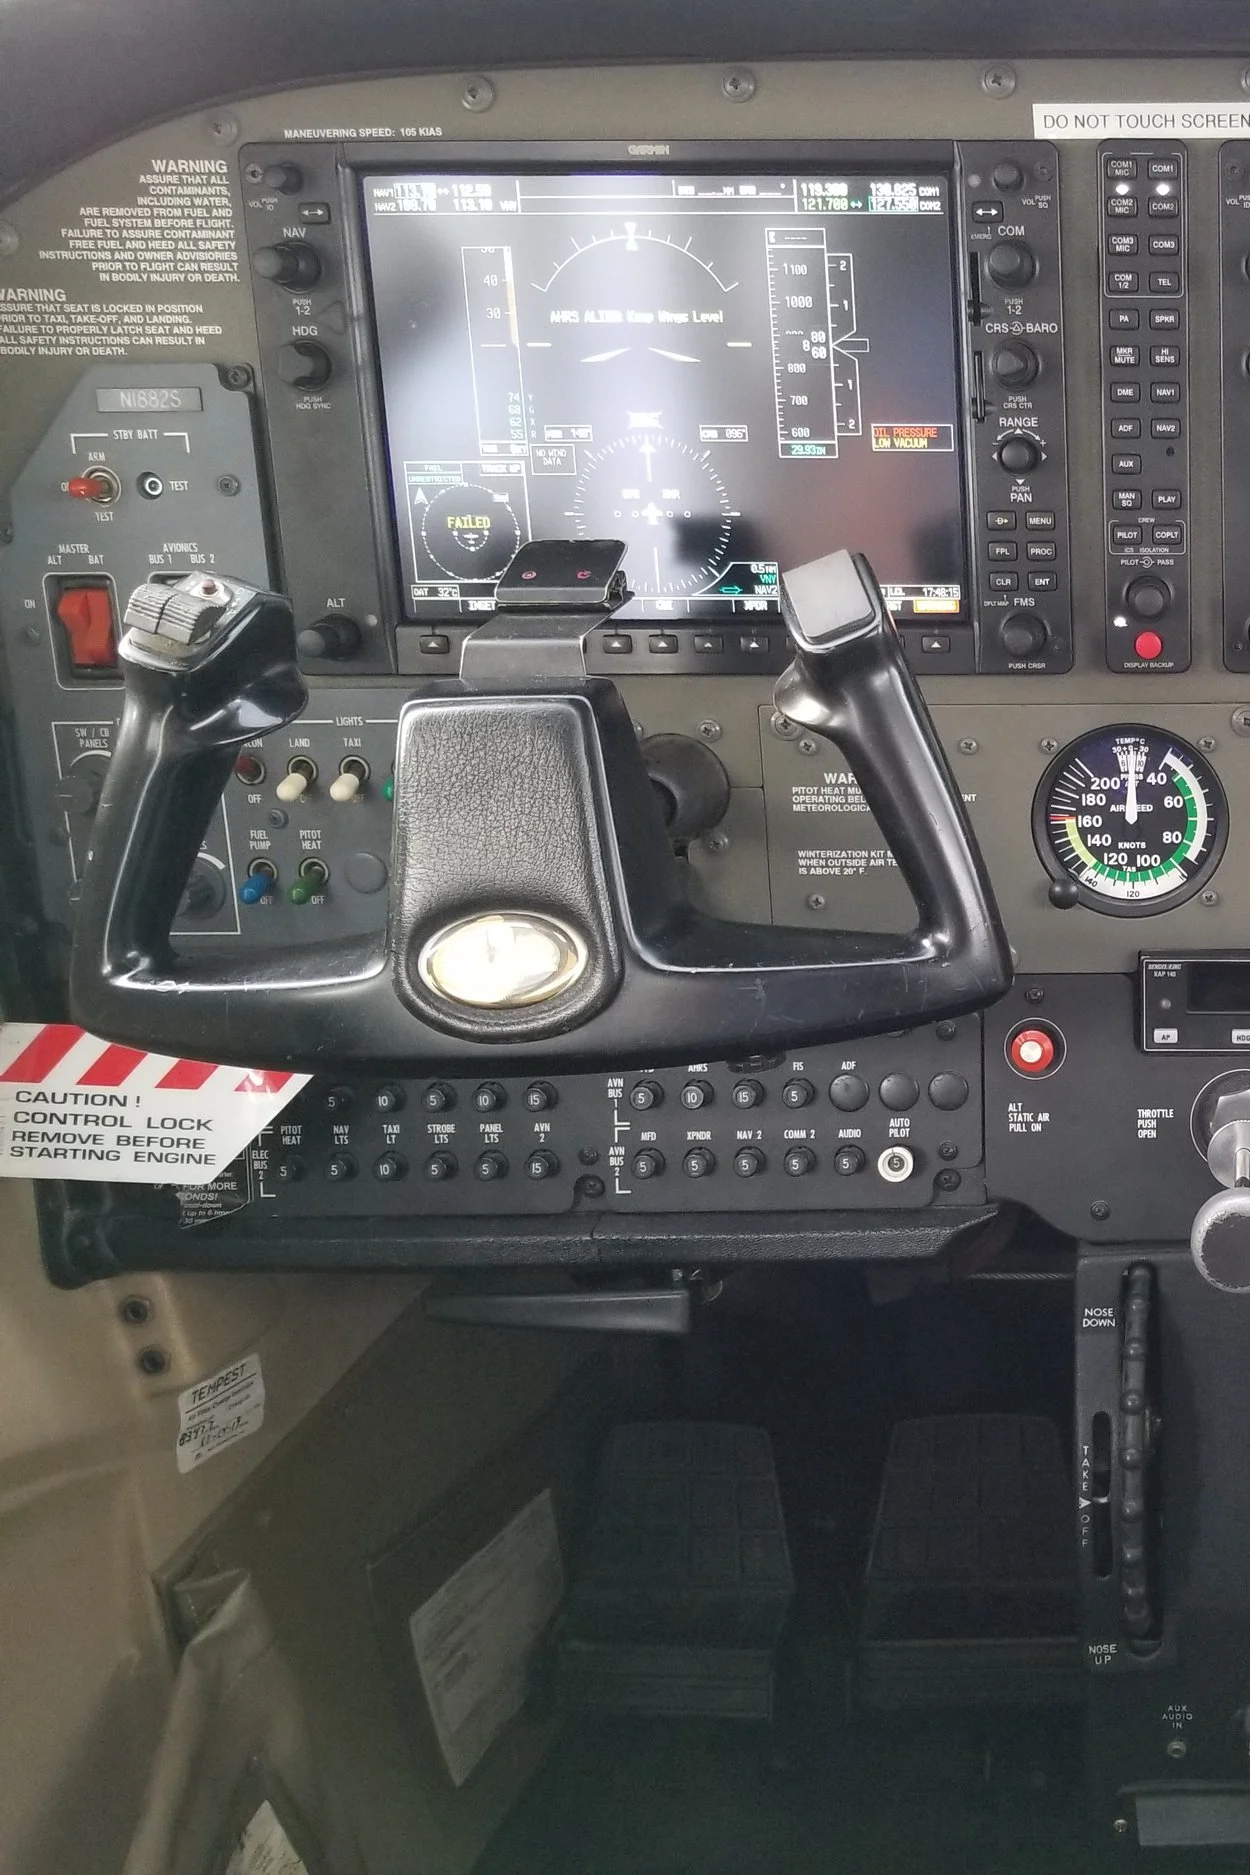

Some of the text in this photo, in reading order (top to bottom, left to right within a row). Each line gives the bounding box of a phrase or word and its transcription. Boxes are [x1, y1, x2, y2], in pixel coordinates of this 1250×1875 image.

[1044, 115, 1068, 128] DO
[1075, 115, 1109, 128] NOT
[1116, 114, 1174, 128] TOUCH
[284, 127, 442, 138] MANEUVERING SPEED: 105 KIAS
[152, 160, 227, 172] WARNING
[140, 175, 229, 184] ASSURE THAT ALL
[150, 186, 230, 196] CONTAMINANTS,
[138, 197, 231, 206] INCLUDING WATER,
[85, 218, 233, 227] FUEL SYSTEM BEFORE FLIGHT.
[283, 228, 305, 237] NAV
[998, 226, 1024, 236] COM
[783, 263, 807, 274] 1100
[100, 273, 109, 281] IN
[112, 273, 147, 281] BODILY
[188, 274, 202, 282] OR
[204, 274, 240, 282] DEATH.
[785, 296, 812, 307] 1000
[76, 347, 90, 355] OR
[92, 347, 127, 355] DEATH.
[1115, 355, 1134, 363] MUTE
[790, 396, 808, 405] 700
[1000, 417, 1038, 428] RANGE
[114, 430, 158, 439] STBY BATT
[790, 428, 809, 437] 600
[873, 426, 936, 439] OIL PRESSURE
[874, 438, 927, 448] LOW VACUUM
[170, 481, 188, 490] TEST
[1011, 492, 1032, 502] PAN
[448, 516, 490, 530] FAILED
[59, 544, 90, 553] MASTER
[164, 543, 197, 552] AVIONICS
[48, 556, 61, 564] ALT
[88, 555, 103, 564] BAT
[921, 586, 960, 598] 17:48:15
[1014, 598, 1034, 606] FMS
[335, 717, 364, 726] LIGHTS
[289, 738, 310, 747] LAND
[344, 738, 361, 746] TAXI
[1091, 776, 1121, 789] 200
[1147, 773, 1166, 785] 40
[1081, 794, 1106, 806] 180
[1164, 796, 1184, 808] 60
[1077, 816, 1102, 829] 160
[250, 830, 268, 839] FUEL
[300, 830, 321, 839] PITOT
[1163, 832, 1183, 843] 80
[250, 839, 270, 850] PUMP
[301, 839, 321, 849] HEAT
[1087, 834, 1111, 848] 140
[798, 850, 886, 860] WINTERIZATION KIT
[1103, 853, 1127, 866] 120
[1136, 855, 1162, 868] 100
[842, 1061, 856, 1070] ADF
[15, 1090, 140, 1107] CAUTION !
[1008, 1103, 1022, 1112] ALT
[1008, 1113, 1050, 1122] STATIC AIR
[1138, 1109, 1173, 1119] THROTTLE
[13, 1111, 213, 1131] CONTROL LOCK
[890, 1118, 910, 1128] AUTO
[1138, 1120, 1156, 1128] PUSH
[428, 1124, 455, 1134] STROBE
[480, 1124, 503, 1132] PANEL
[1009, 1123, 1041, 1132] PULL ON
[641, 1132, 656, 1140] MFD
[687, 1131, 711, 1140] XPNDR
[784, 1130, 815, 1138] COMM 2
[839, 1129, 861, 1138] AUDIO
[889, 1128, 910, 1137] PILOT
[1138, 1130, 1156, 1138] OPEN
[12, 1131, 206, 1150] REMOVE BEFORE
[435, 1134, 448, 1143] LTS
[485, 1134, 498, 1142] LTS
[10, 1146, 216, 1165] STARTING ENGINE
[1085, 1308, 1113, 1318] NOSE
[1083, 1318, 1115, 1327] DOWN
[1089, 1644, 1116, 1655] NOSE
[1094, 1654, 1111, 1664] UP
